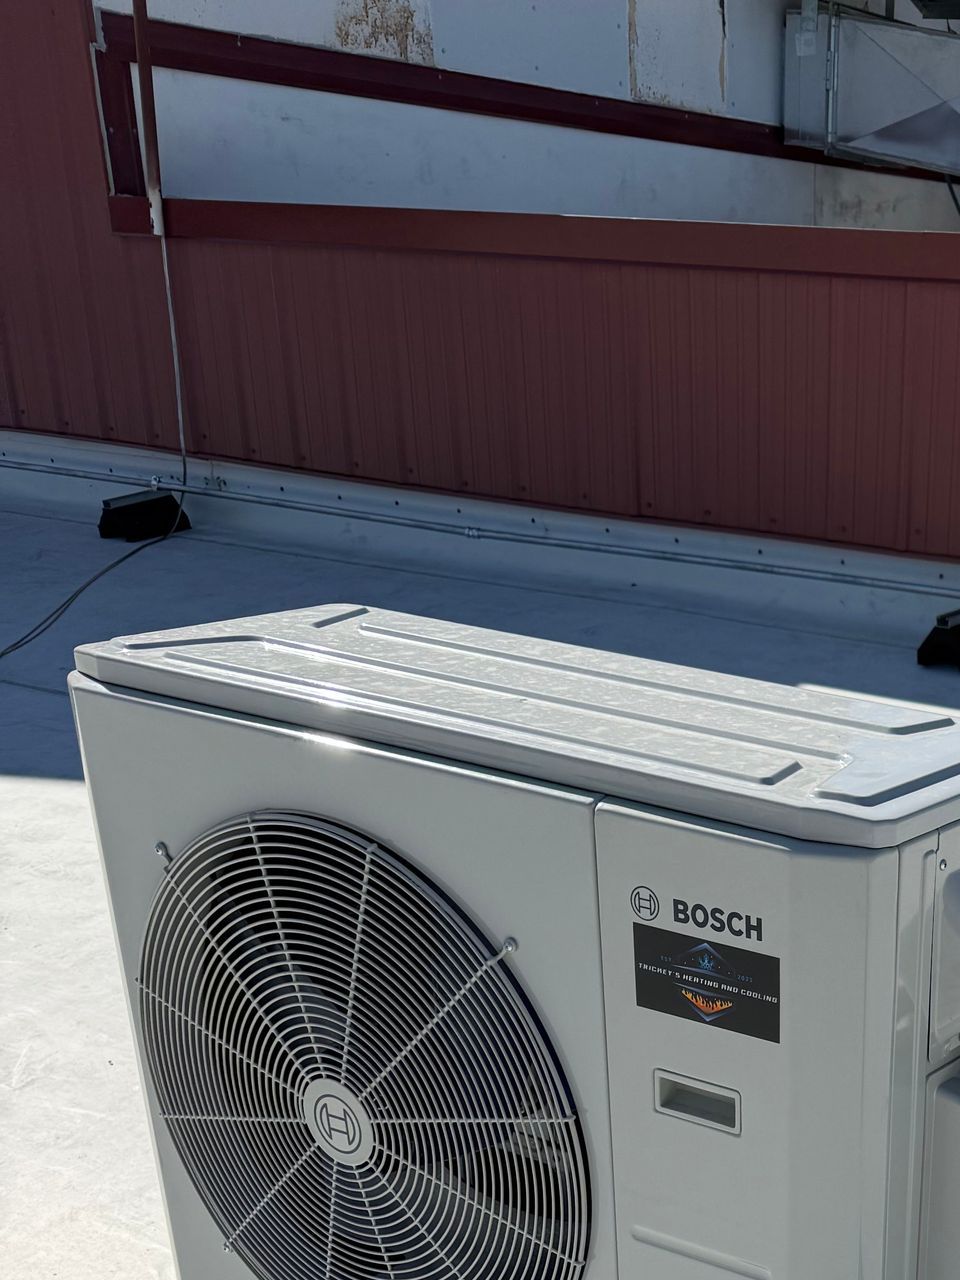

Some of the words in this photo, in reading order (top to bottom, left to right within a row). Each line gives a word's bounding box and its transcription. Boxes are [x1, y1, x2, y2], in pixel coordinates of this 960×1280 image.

[673, 898, 763, 942] BOSCH
[638, 962, 681, 979] TRICKEY'S
[682, 973, 719, 989] HEATING
[720, 983, 739, 994] AND
[740, 988, 778, 1004] COOLING
